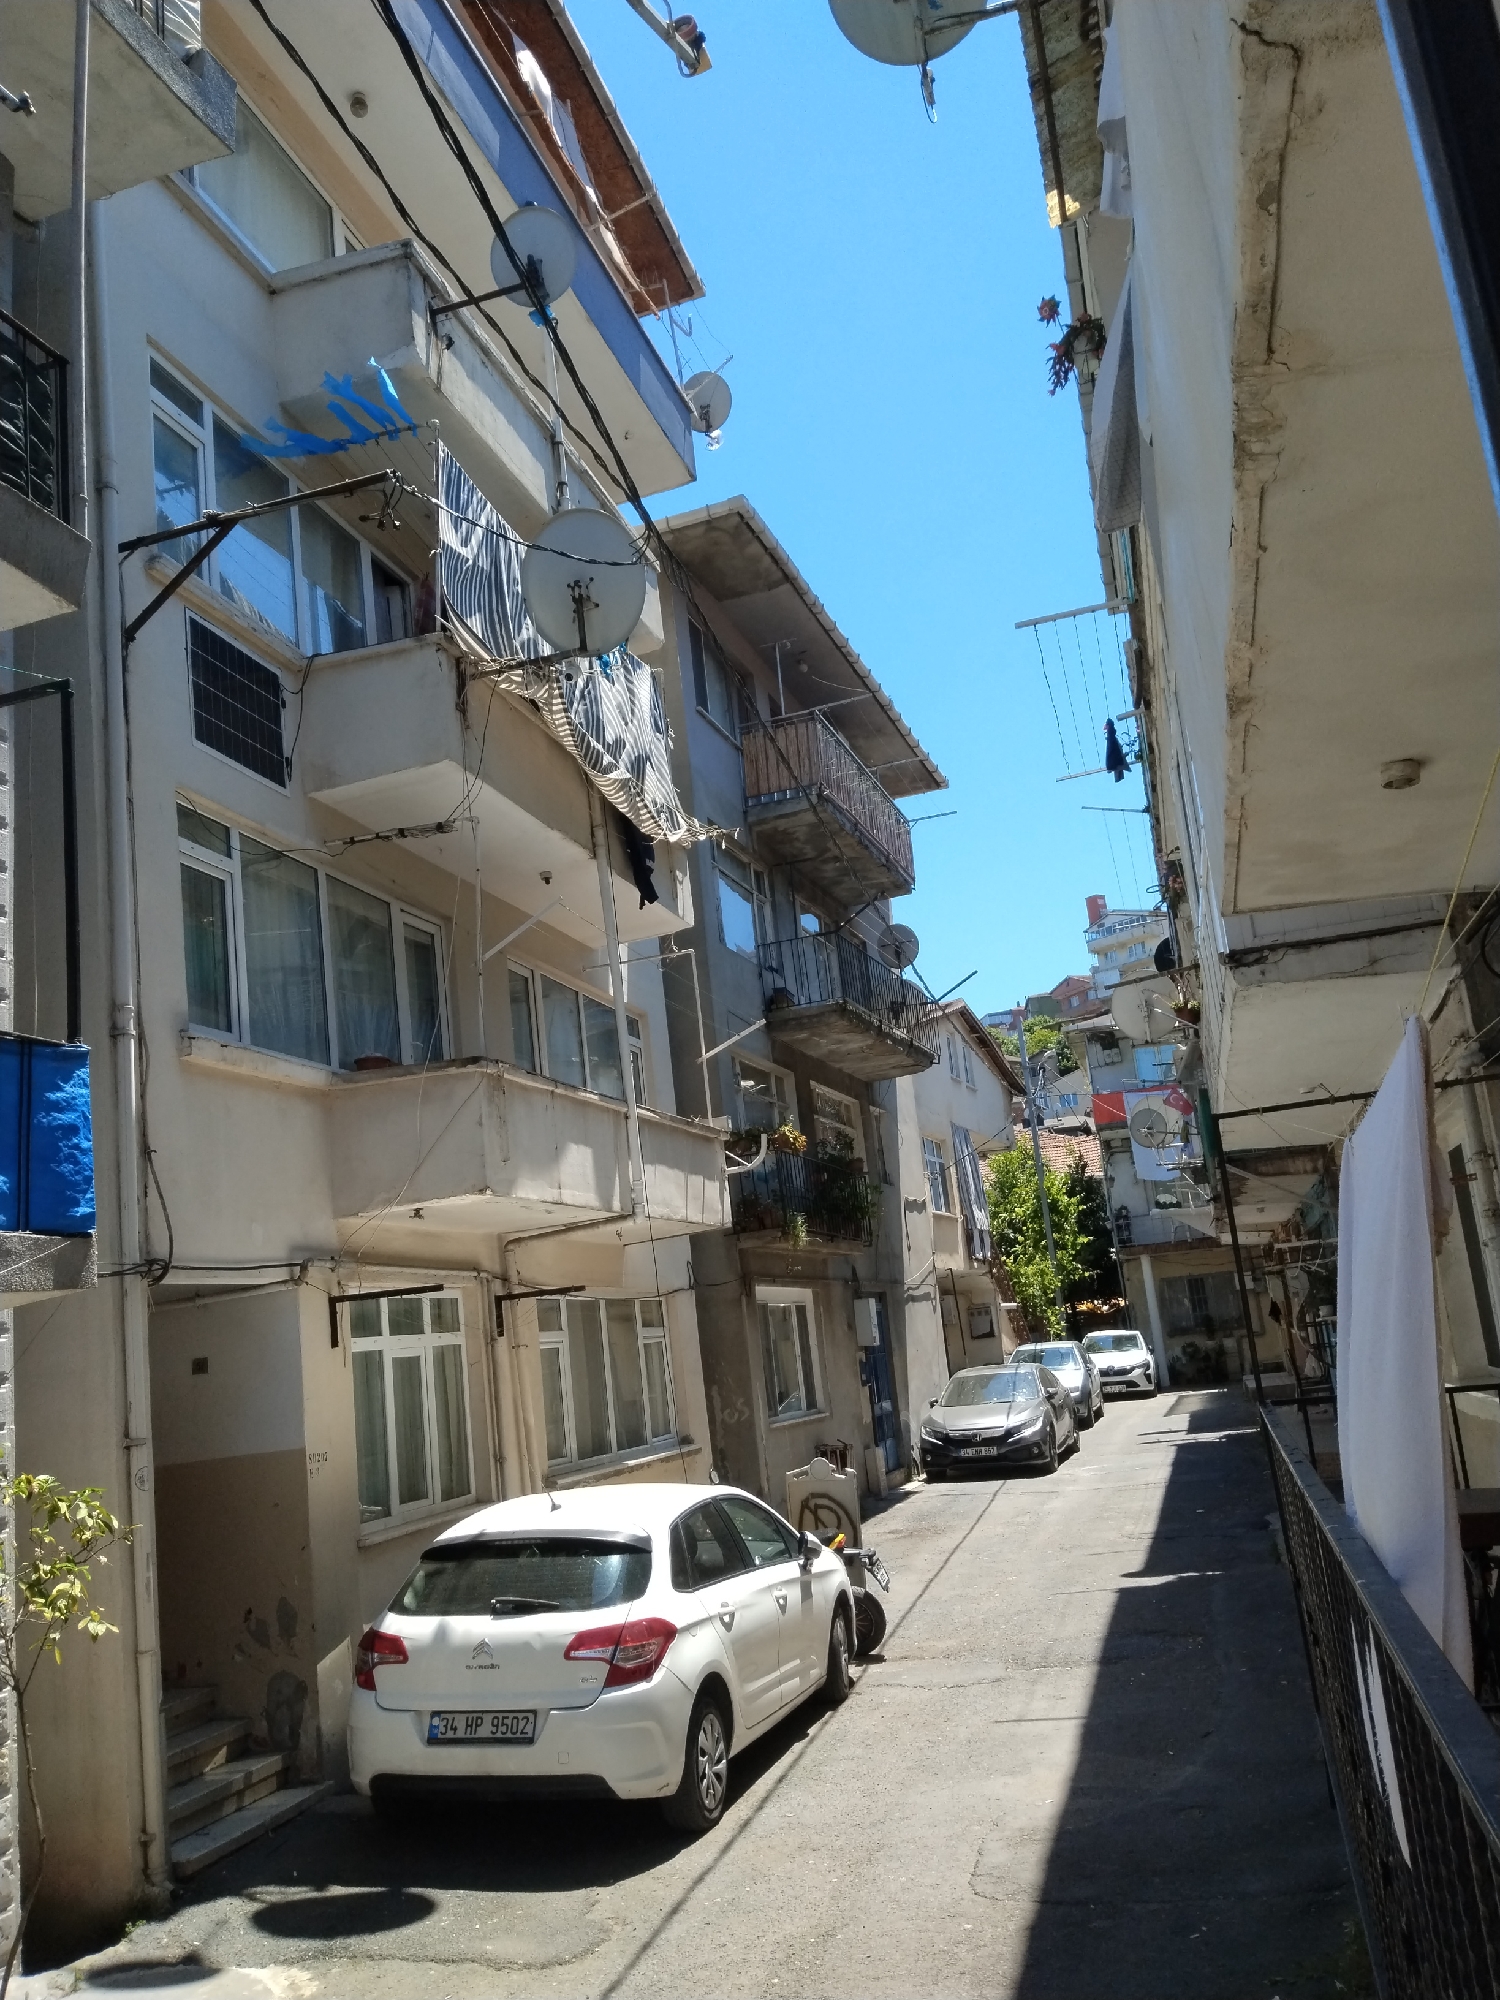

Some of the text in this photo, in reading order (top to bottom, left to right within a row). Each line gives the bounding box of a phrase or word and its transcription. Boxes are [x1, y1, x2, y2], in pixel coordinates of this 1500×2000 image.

[439, 1715, 530, 1736] 34 HP 9502
